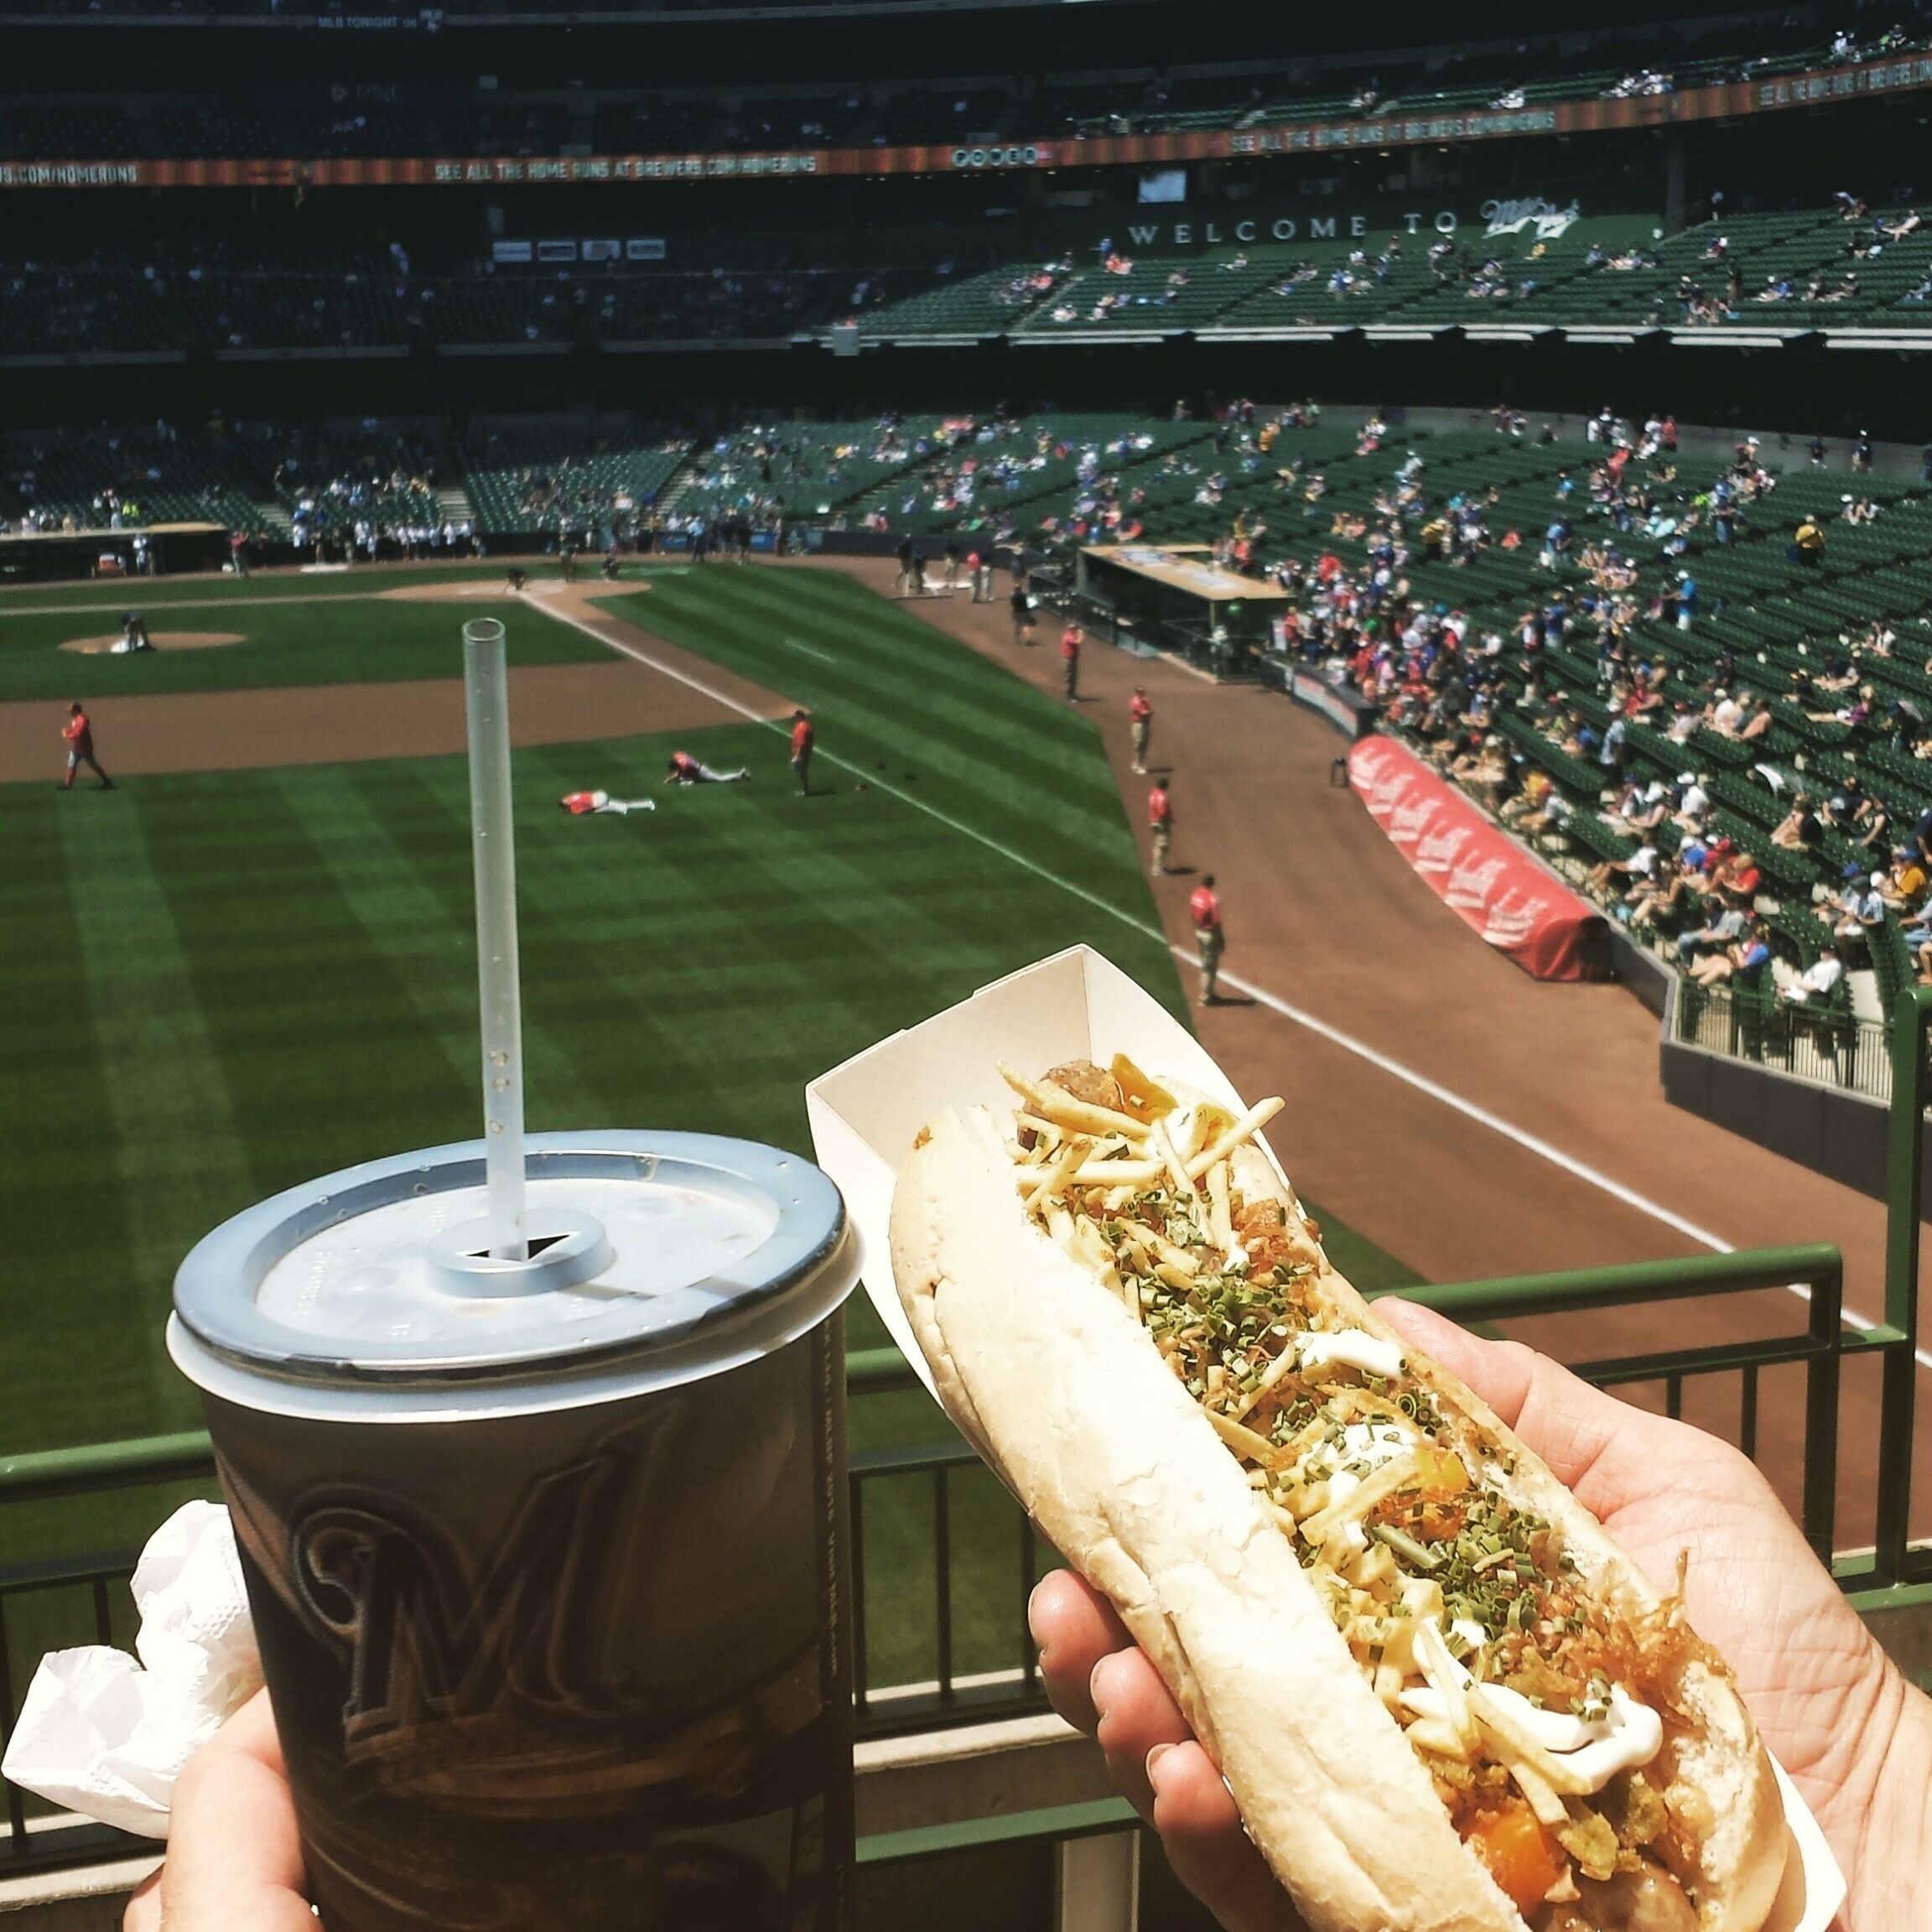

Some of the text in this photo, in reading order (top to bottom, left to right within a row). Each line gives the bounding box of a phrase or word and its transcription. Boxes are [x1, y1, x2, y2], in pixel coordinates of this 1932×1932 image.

[467, 163, 492, 179] ALL
[497, 162, 524, 179] THE
[527, 163, 568, 179] HOME
[1128, 211, 1457, 245] WELCOME TO
